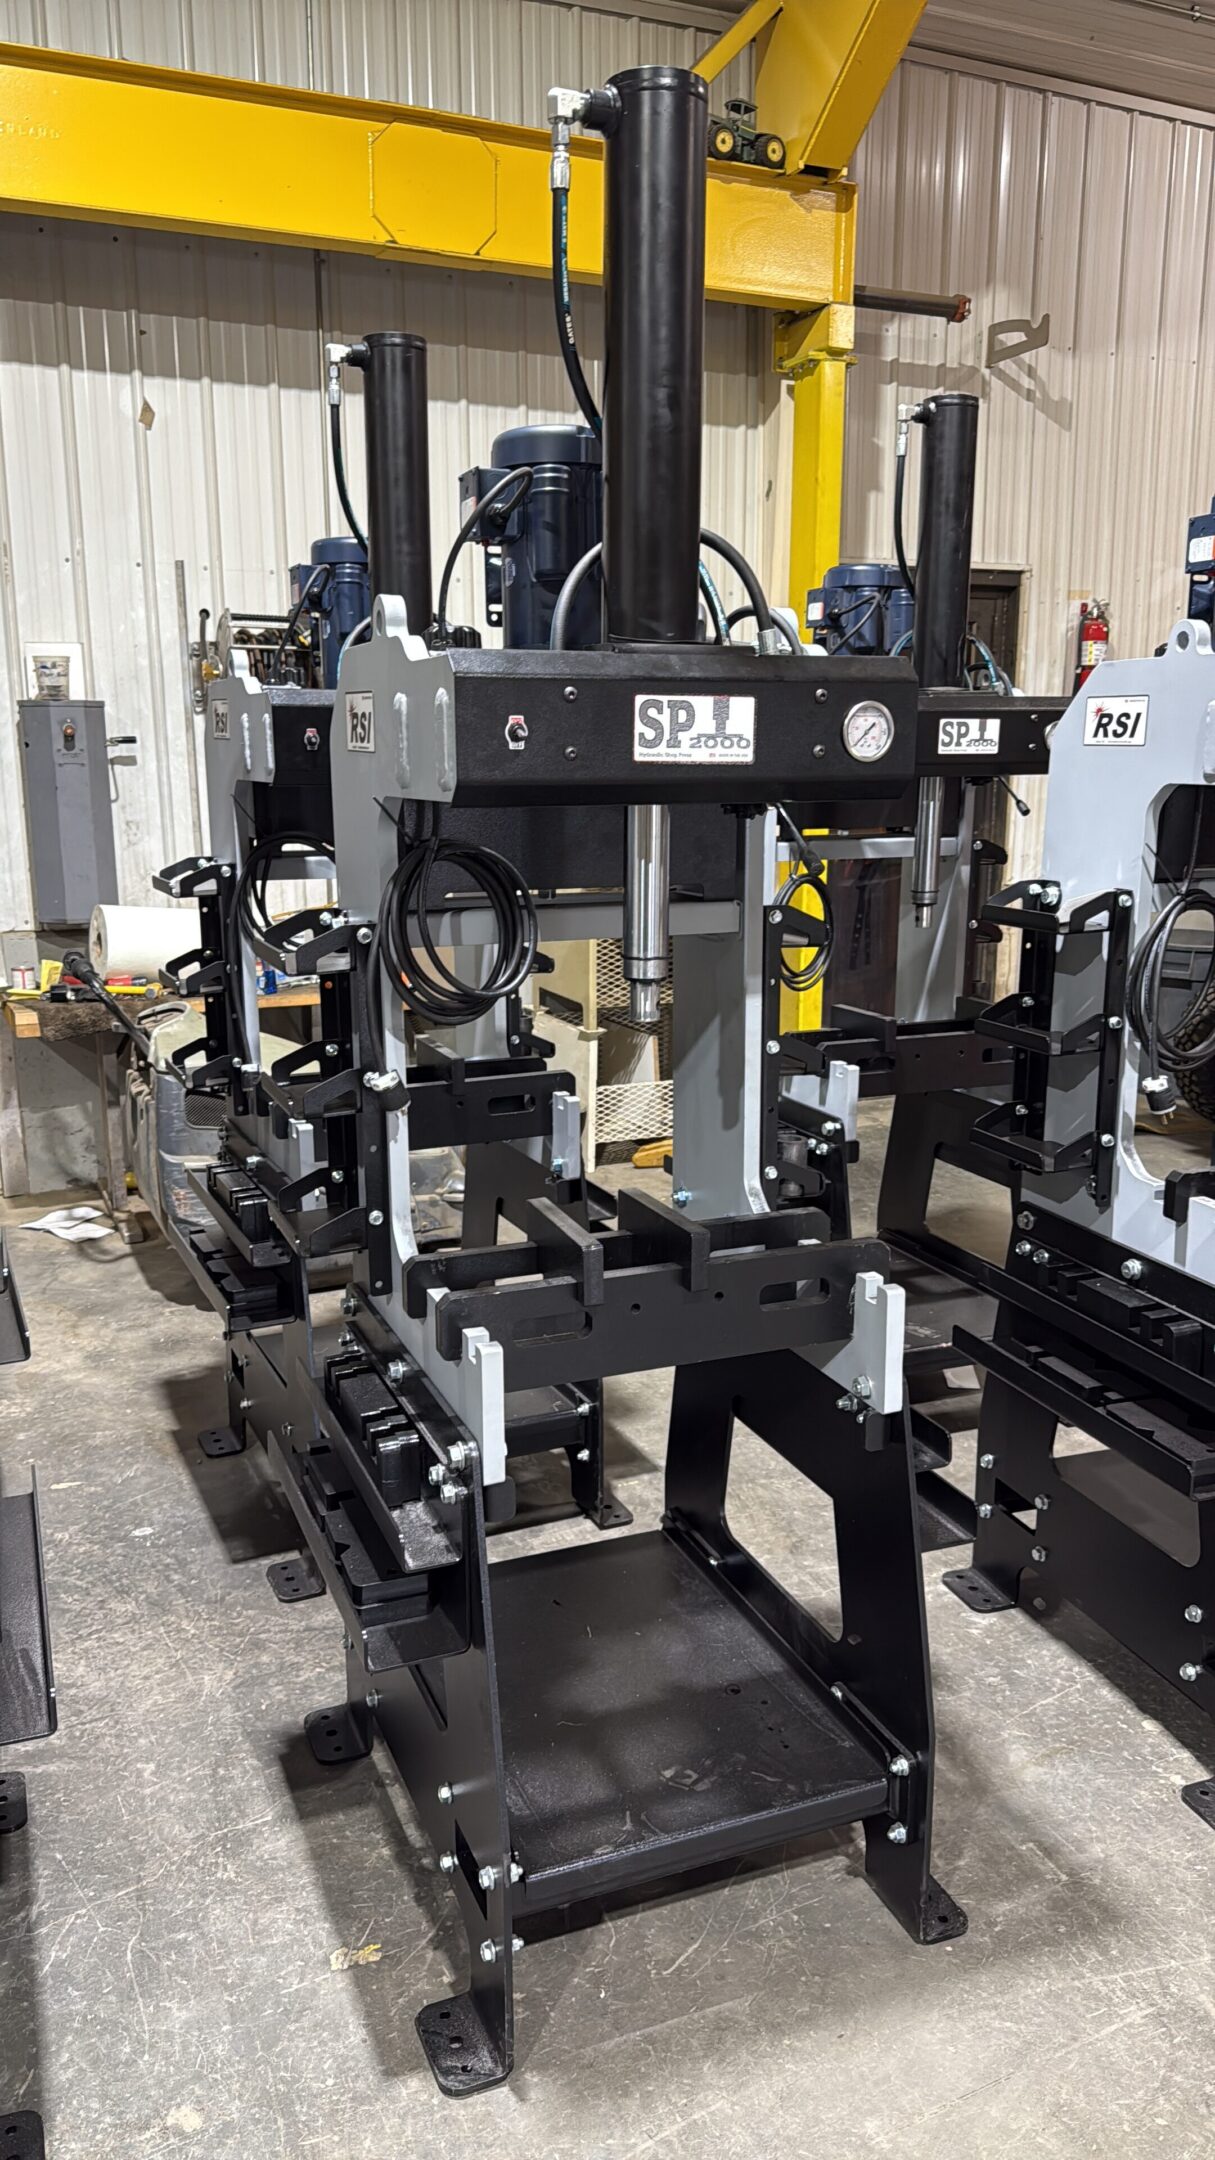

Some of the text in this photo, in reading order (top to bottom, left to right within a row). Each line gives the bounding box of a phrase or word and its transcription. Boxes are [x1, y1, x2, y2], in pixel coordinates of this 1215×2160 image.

[350, 711, 372, 744] RSI
[638, 698, 751, 749] SP 2000
[941, 720, 970, 747] SP
[1092, 712, 1142, 739] RSI
